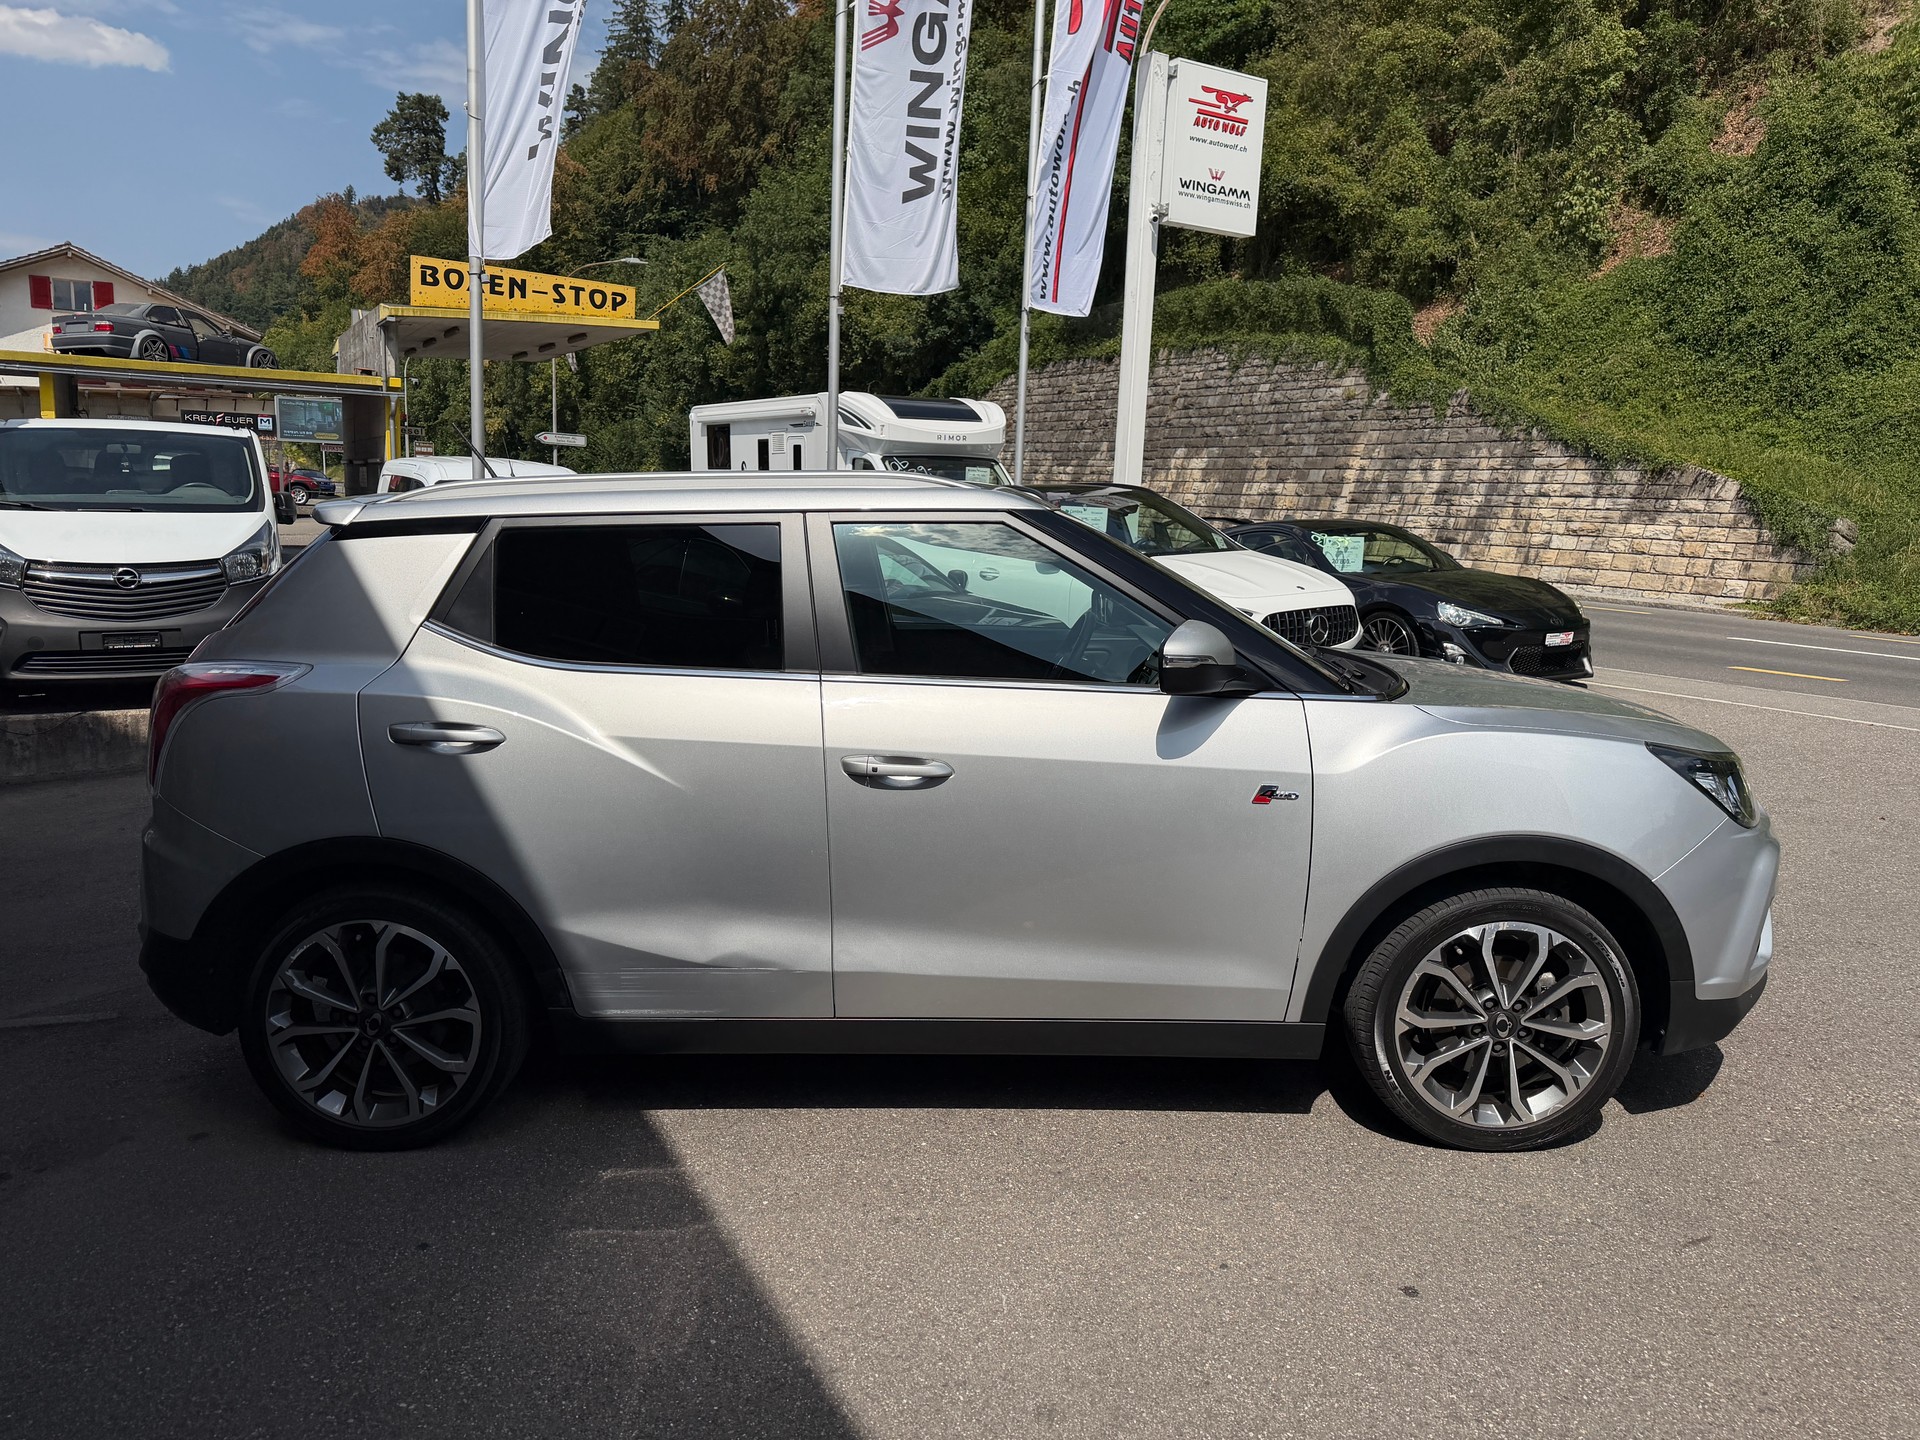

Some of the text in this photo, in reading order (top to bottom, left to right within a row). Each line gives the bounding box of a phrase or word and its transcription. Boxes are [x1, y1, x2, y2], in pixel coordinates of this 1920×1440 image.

[901, 0, 949, 204] WING
[1193, 116, 1247, 137] AUTO WOLF
[1189, 135, 1248, 153] www.autowolf.ch
[1179, 177, 1251, 201] WINGAMM
[1178, 190, 1251, 209] www.wingammswiss.ch
[184, 412, 254, 425] KREAFEUER
[936, 434, 968, 442] RIMOR
